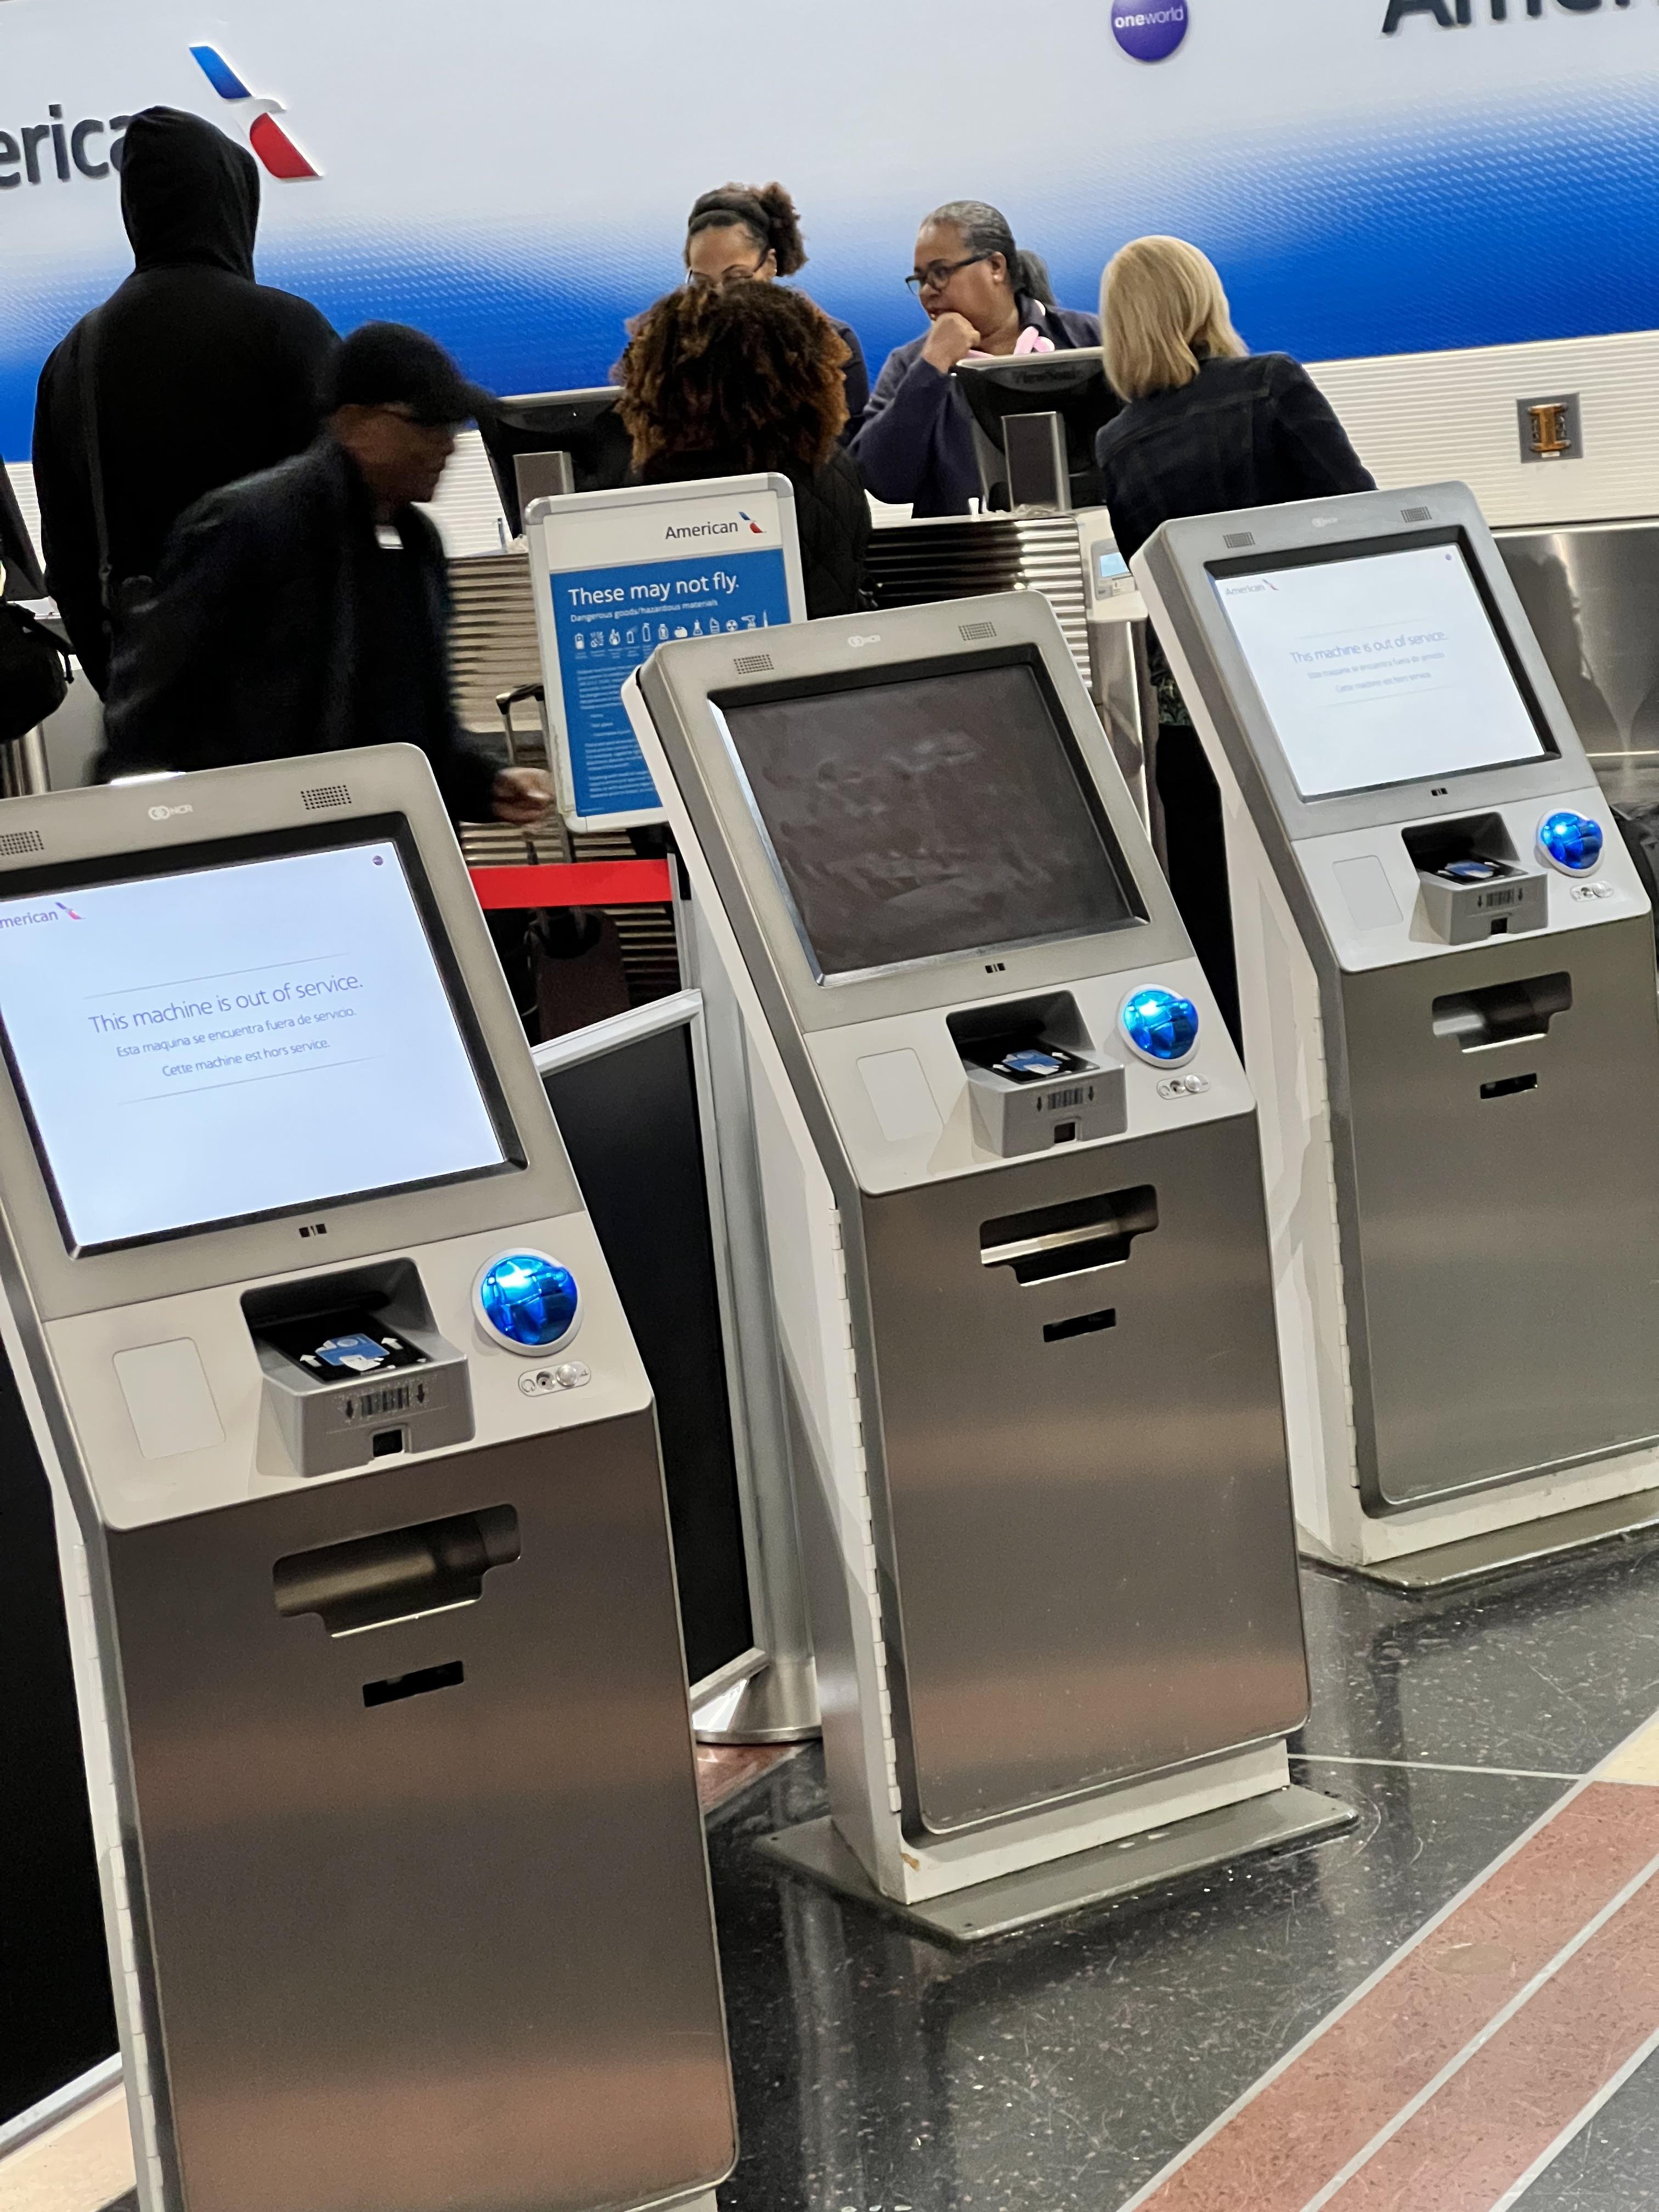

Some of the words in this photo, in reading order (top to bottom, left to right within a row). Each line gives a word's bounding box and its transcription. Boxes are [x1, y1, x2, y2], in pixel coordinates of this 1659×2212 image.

[1115, 6, 1184, 28] oneworld
[665, 522, 738, 539] American
[568, 588, 624, 605] These
[631, 582, 670, 601] may
[676, 577, 709, 594] not
[713, 572, 740, 594] fly.
[571, 612, 613, 622] Dangerous
[682, 599, 718, 610] materials
[1290, 651, 1314, 664] This
[1315, 644, 1362, 660] machine
[1362, 643, 1372, 653] is
[1373, 639, 1393, 651] out
[1395, 634, 1406, 648] of
[88, 1013, 129, 1033] This
[133, 1001, 213, 1026] machine
[216, 995, 232, 1012] is
[236, 990, 270, 1008] out
[273, 982, 291, 1002] of
[296, 975, 363, 998] service.
[116, 1046, 140, 1057] Esta
[143, 1037, 191, 1052] maquina
[193, 1034, 206, 1044] se
[208, 1024, 264, 1041] encuentra
[266, 1020, 295, 1030] fuera
[297, 1014, 312, 1025] de
[162, 1064, 193, 1077] Cette
[195, 1056, 242, 1070] machine
[245, 1051, 263, 1062] est
[263, 1048, 289, 1059] hors
[290, 1040, 331, 1054] service.
